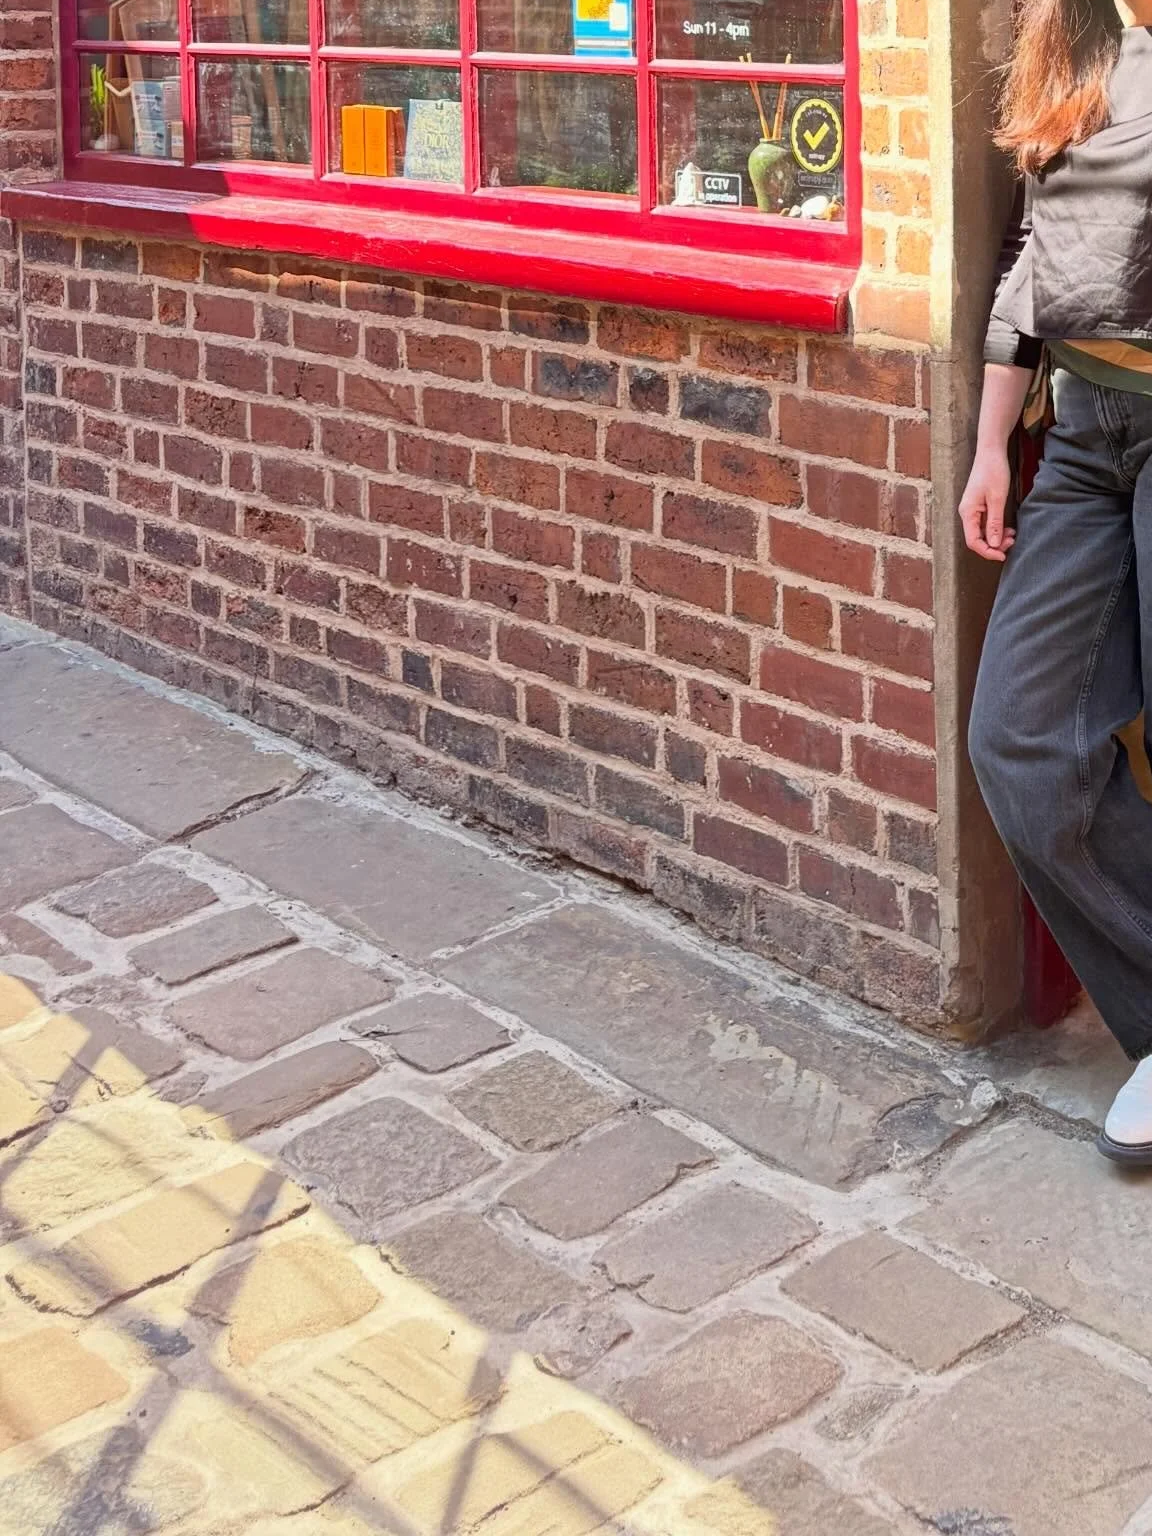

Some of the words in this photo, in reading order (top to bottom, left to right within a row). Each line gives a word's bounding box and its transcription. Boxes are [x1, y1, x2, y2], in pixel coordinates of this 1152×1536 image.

[683, 20, 704, 35] Sun
[705, 21, 716, 35] 11
[725, 22, 749, 40] 4pm
[424, 133, 449, 148] DIOR
[704, 176, 730, 190] CCTV
